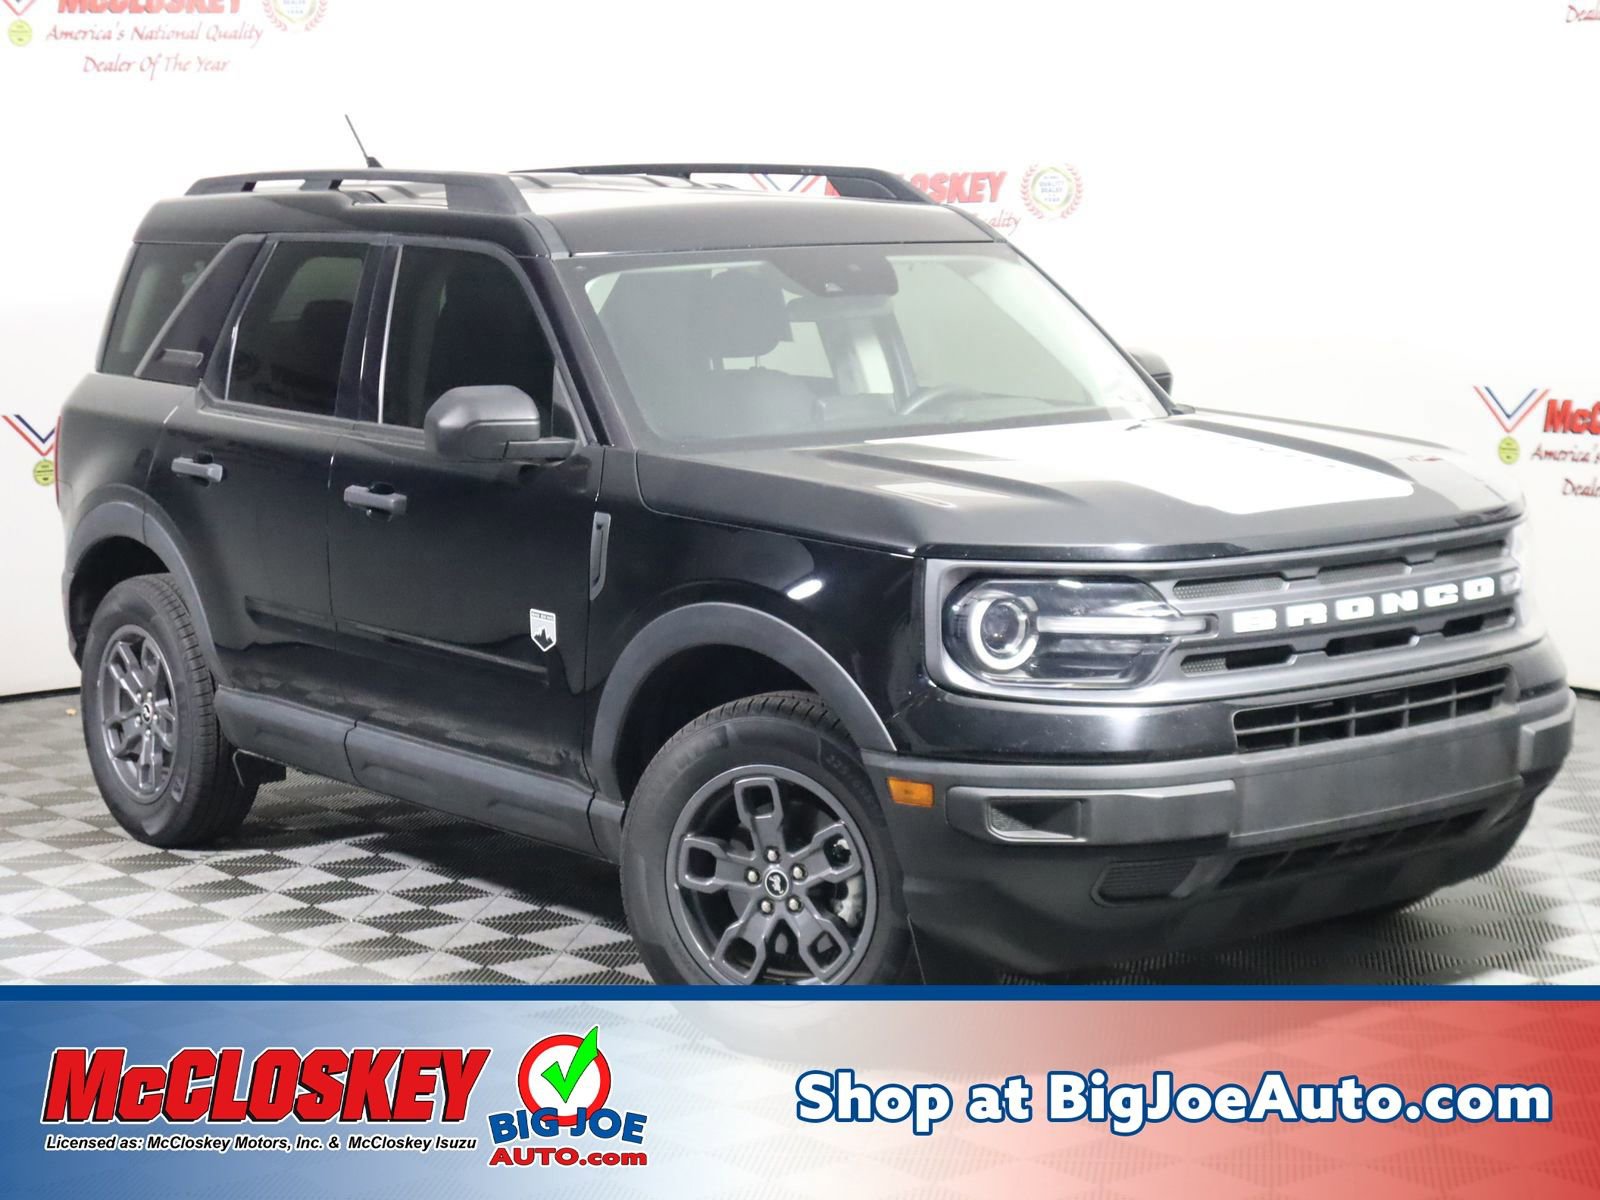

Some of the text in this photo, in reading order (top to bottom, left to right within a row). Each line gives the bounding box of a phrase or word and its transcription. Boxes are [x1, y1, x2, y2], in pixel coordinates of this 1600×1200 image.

[46, 21, 125, 41] America's
[130, 21, 201, 41] National
[205, 20, 264, 48] Quality
[82, 53, 231, 80] Dealer Of The Year
[1231, 575, 1496, 634] BRONCO
